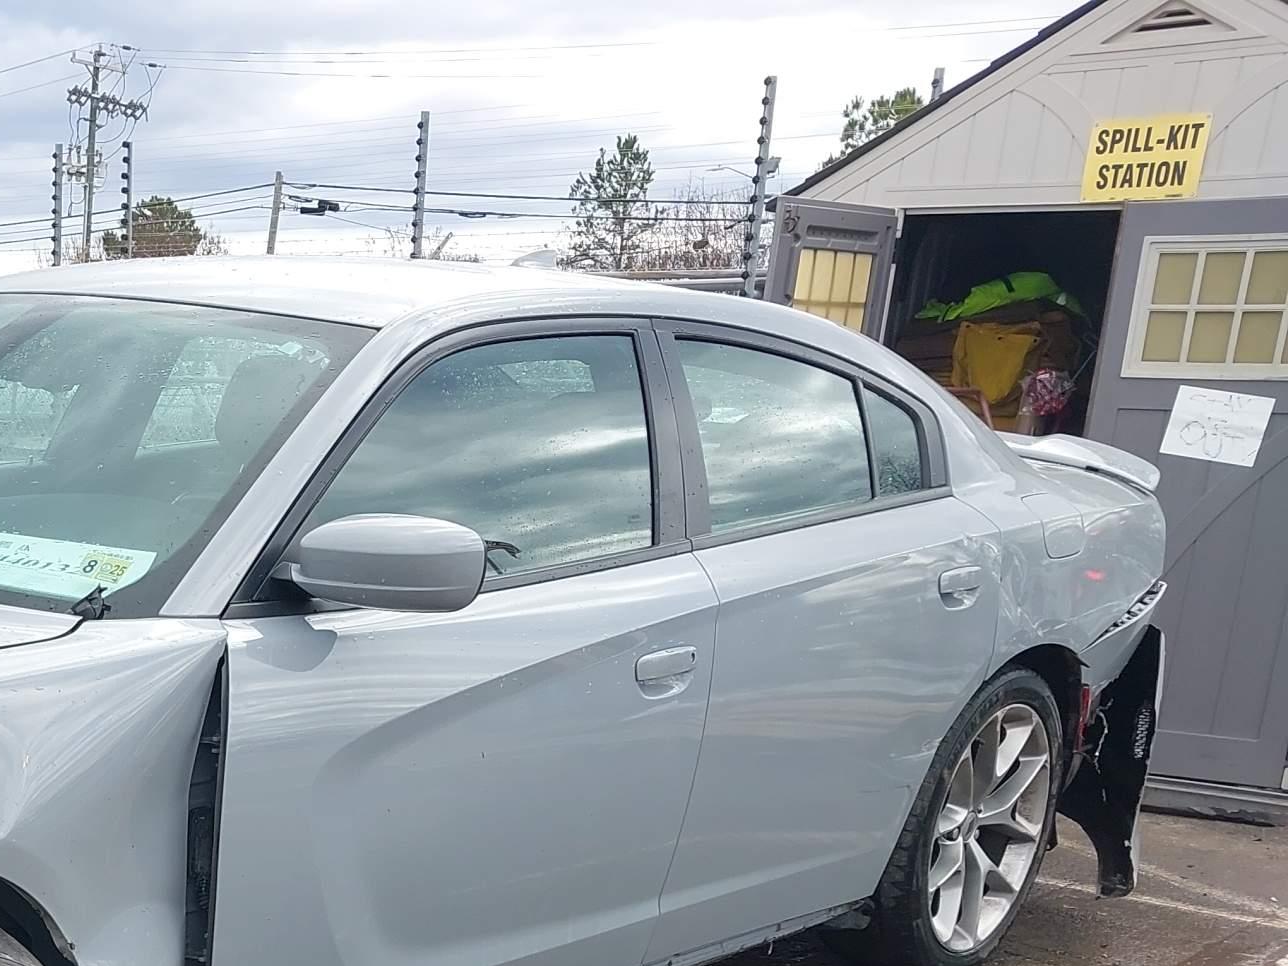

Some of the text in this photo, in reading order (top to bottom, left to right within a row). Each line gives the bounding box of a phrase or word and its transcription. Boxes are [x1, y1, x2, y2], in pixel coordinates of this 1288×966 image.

[1095, 122, 1205, 155] SPILL-KIT
[1095, 160, 1188, 190] STATION
[82, 559, 98, 573] 8
[109, 564, 128, 577] 25
